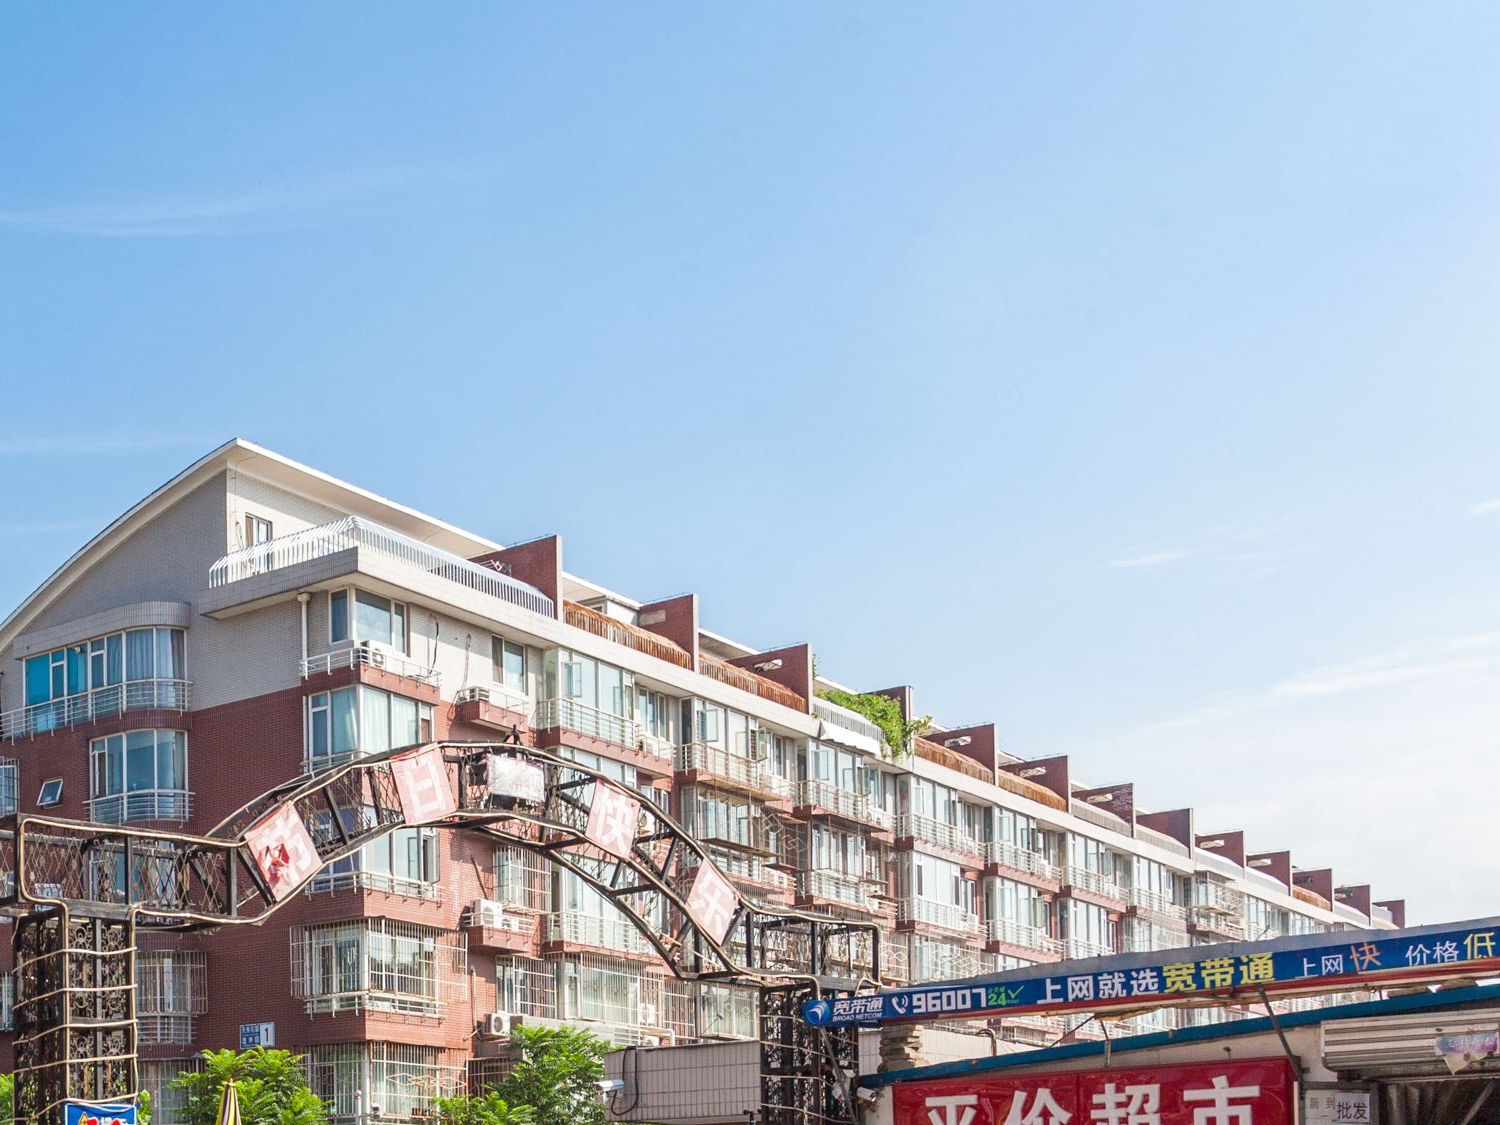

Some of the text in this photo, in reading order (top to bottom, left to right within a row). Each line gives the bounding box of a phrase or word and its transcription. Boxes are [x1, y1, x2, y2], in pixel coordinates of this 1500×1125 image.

[1037, 931, 1496, 1004] 上网就选宽带通 上网快 价格低
[833, 997, 884, 1015] 宽带通
[913, 988, 986, 1013] 96007
[988, 993, 1007, 1006] 24
[833, 1012, 883, 1022] BROAD NETCOM
[264, 1027, 269, 1043] 1
[1337, 1102, 1368, 1120] 批发
